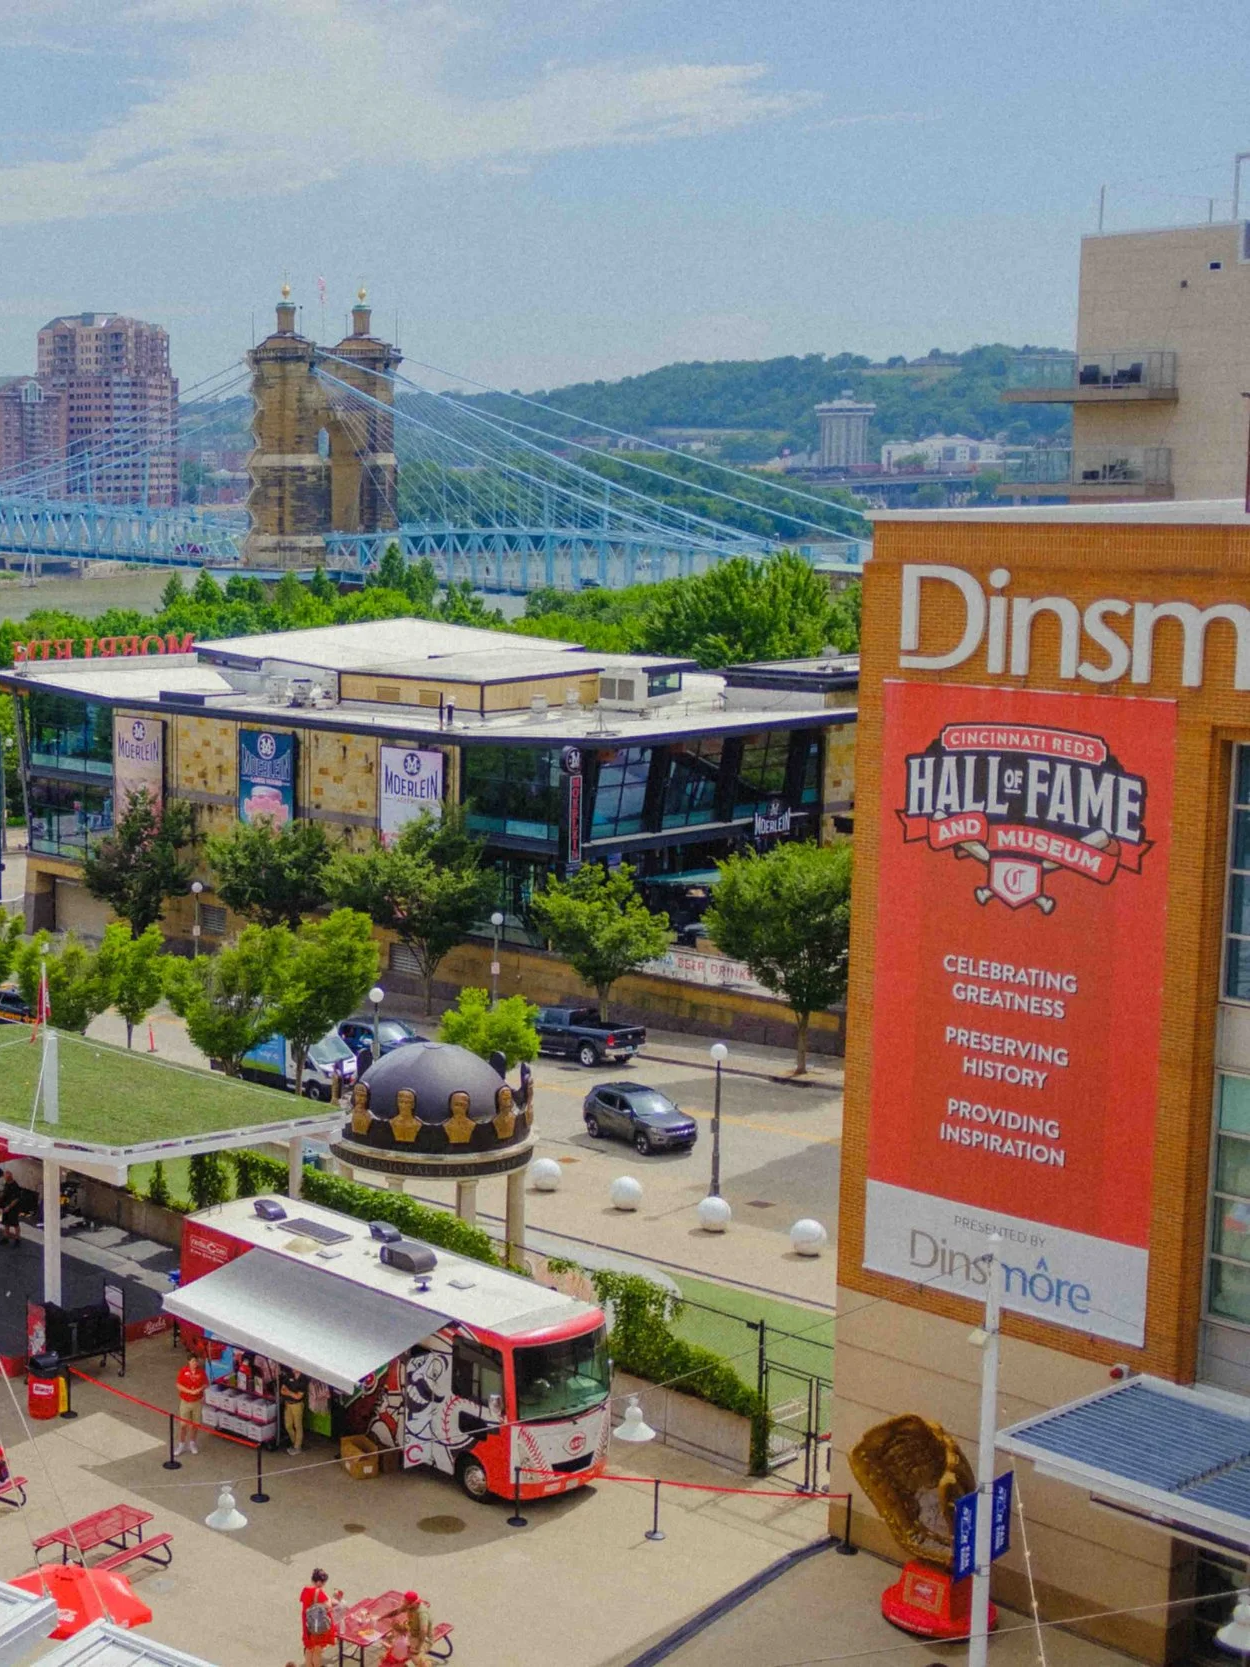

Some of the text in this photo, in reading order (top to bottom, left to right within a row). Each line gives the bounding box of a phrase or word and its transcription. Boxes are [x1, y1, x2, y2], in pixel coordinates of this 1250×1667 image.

[118, 731, 159, 761] MOERLEIN
[241, 744, 291, 781] MOERLEIN
[950, 731, 1095, 757] CINCINNATI REDS
[385, 763, 438, 800] MOERLEIN
[907, 755, 1143, 843] HALL OF FAME
[755, 807, 791, 836] MOERLEIN
[938, 818, 1103, 873] AND MUSEUM
[677, 957, 705, 971] BEER
[943, 954, 1077, 994] CELEBRATING
[952, 982, 1066, 1020] GREATNESS
[945, 1026, 1069, 1067] PRESERVING
[962, 1056, 1049, 1090] HISTORY
[947, 1097, 1061, 1140] PROVIDING
[940, 1122, 1066, 1168] INSPIRATION
[438, 1164, 477, 1176] TEAM
[954, 1215, 1047, 1249] PRESENTED BY
